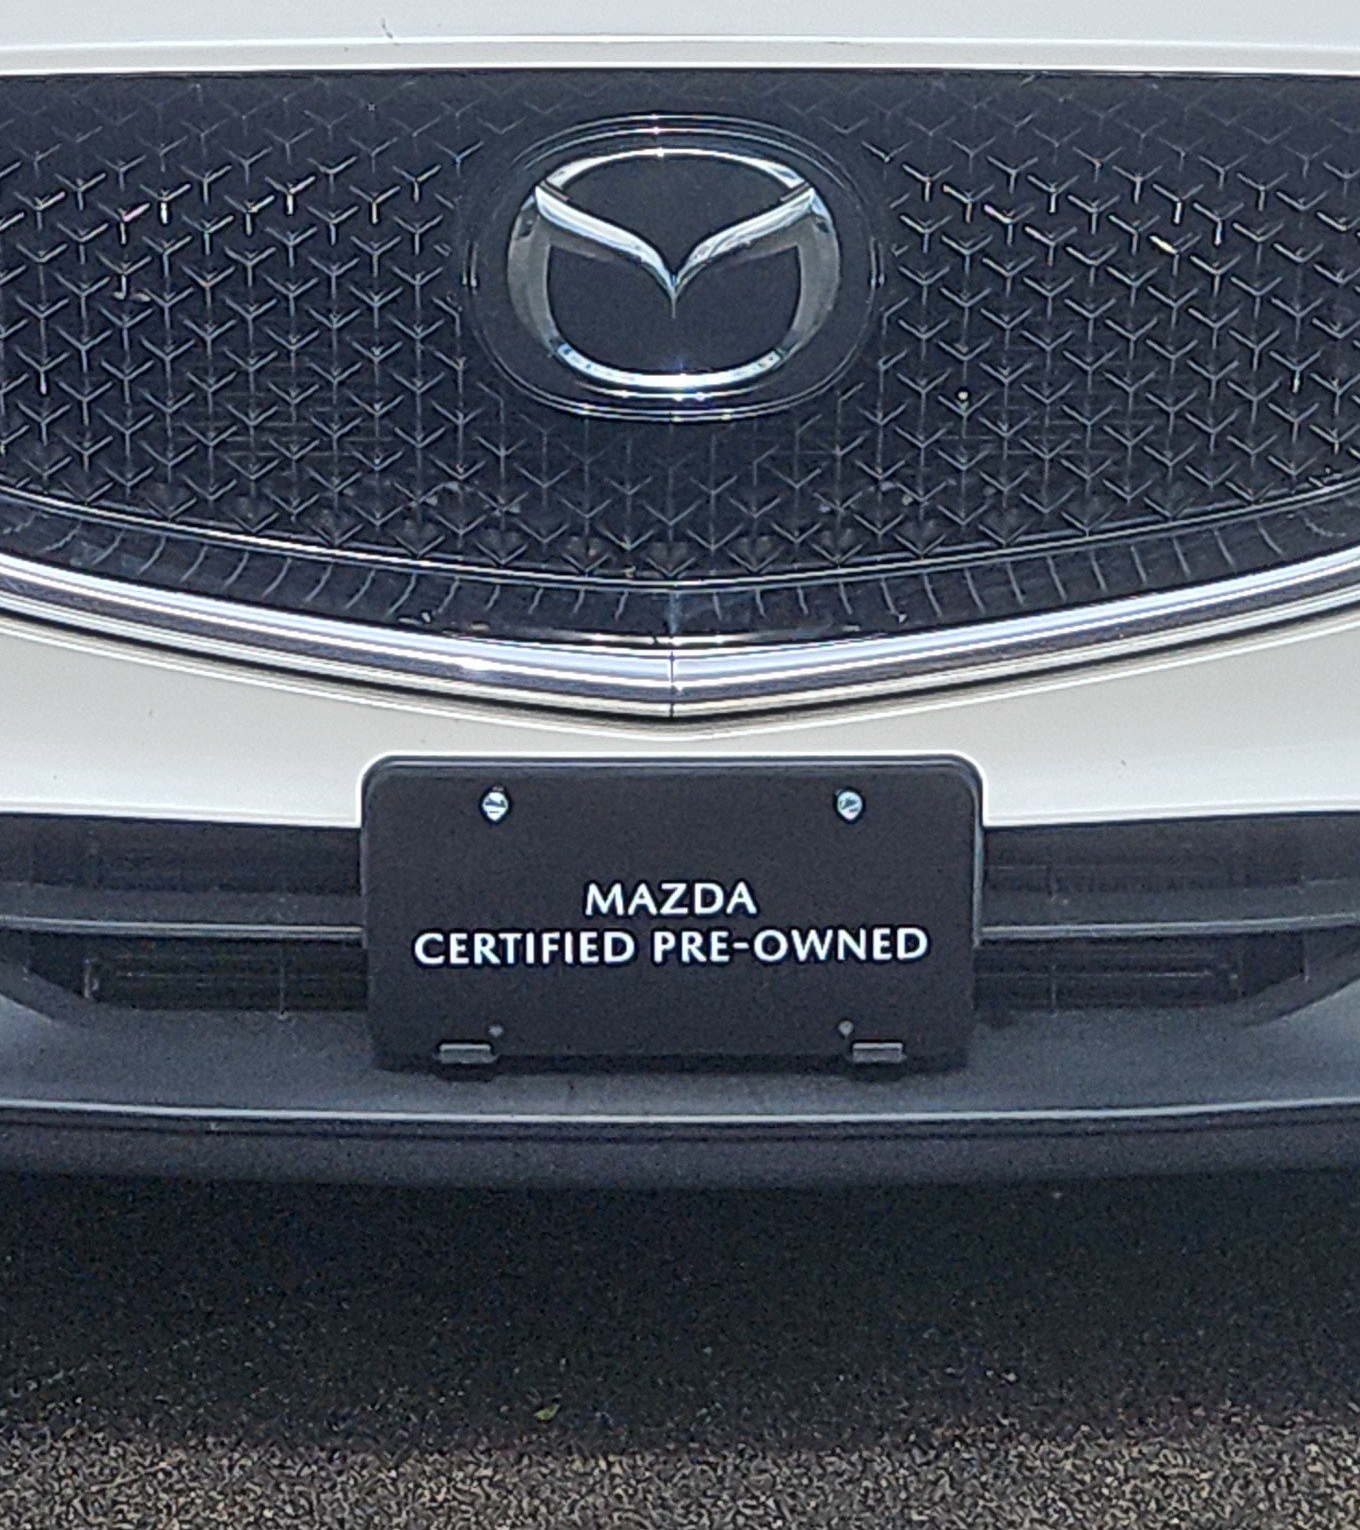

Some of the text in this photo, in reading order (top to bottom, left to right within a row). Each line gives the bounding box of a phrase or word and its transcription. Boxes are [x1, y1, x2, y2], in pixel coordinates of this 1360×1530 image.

[584, 880, 758, 917] MAZDA
[413, 926, 929, 966] CERTIFIED PRE-OWNED
